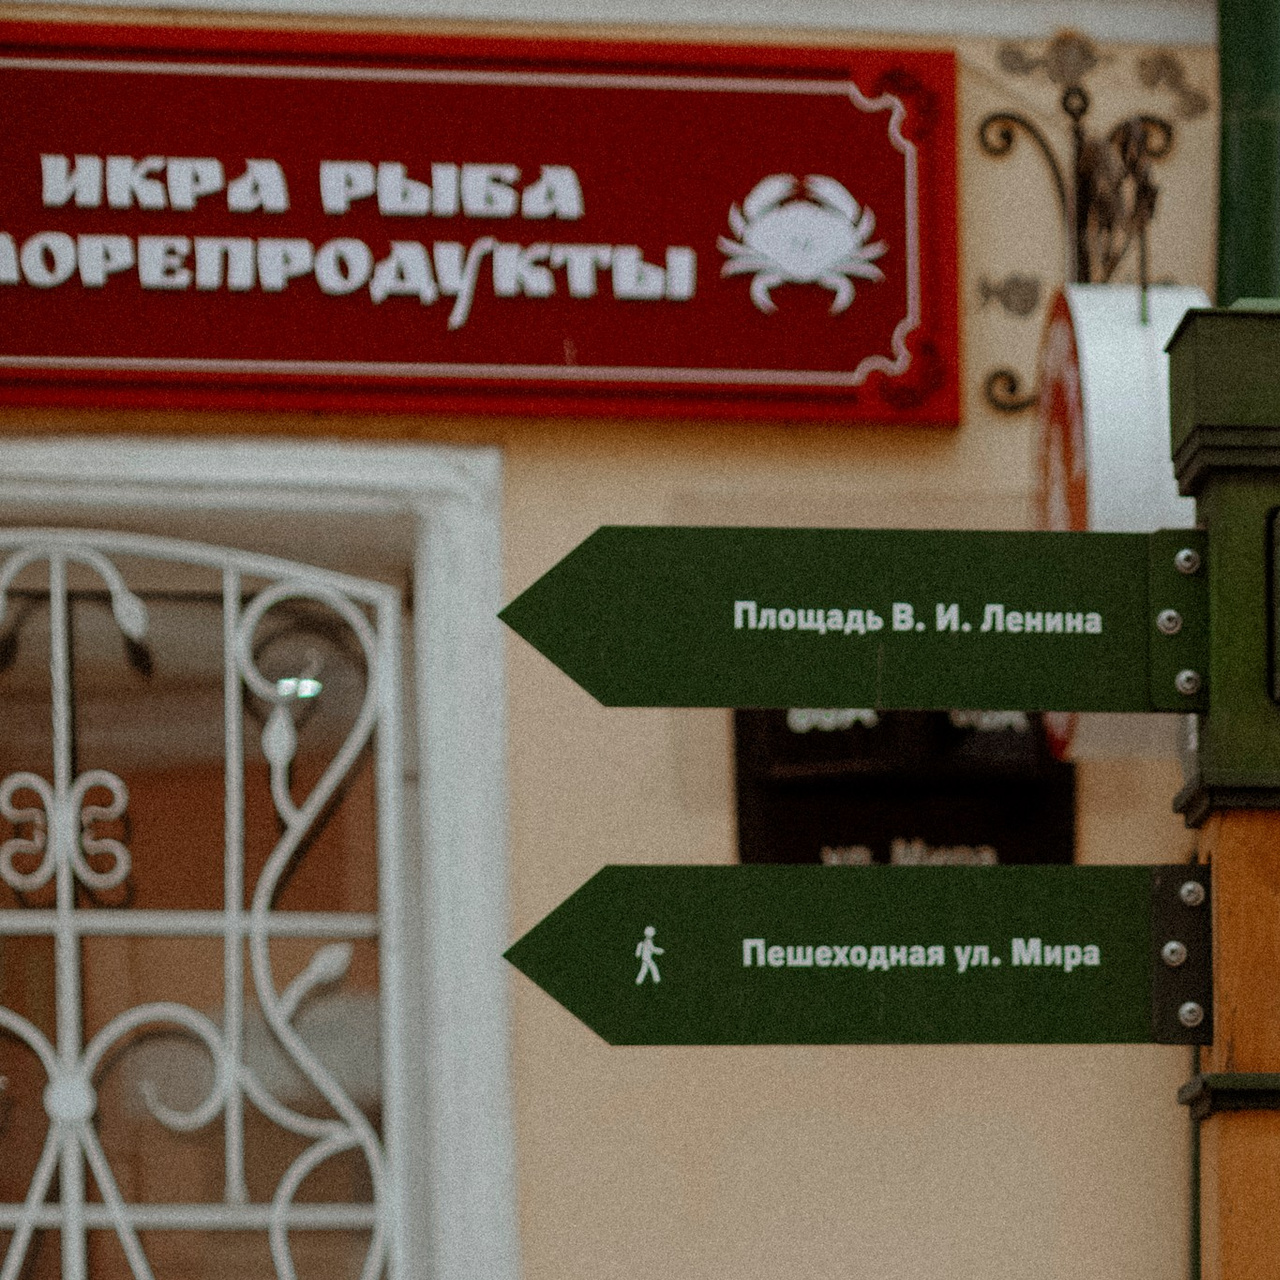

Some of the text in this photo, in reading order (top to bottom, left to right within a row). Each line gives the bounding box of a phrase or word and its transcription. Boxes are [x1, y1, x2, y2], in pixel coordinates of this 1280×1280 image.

[40, 154, 584, 219] ИКРА РЫБА
[0, 231, 696, 328] ОРЕПРОДУКТЫ
[733, 600, 1102, 635] Площадь В. И. Ленина
[742, 937, 1100, 973] Пешеходная ул. Мира
